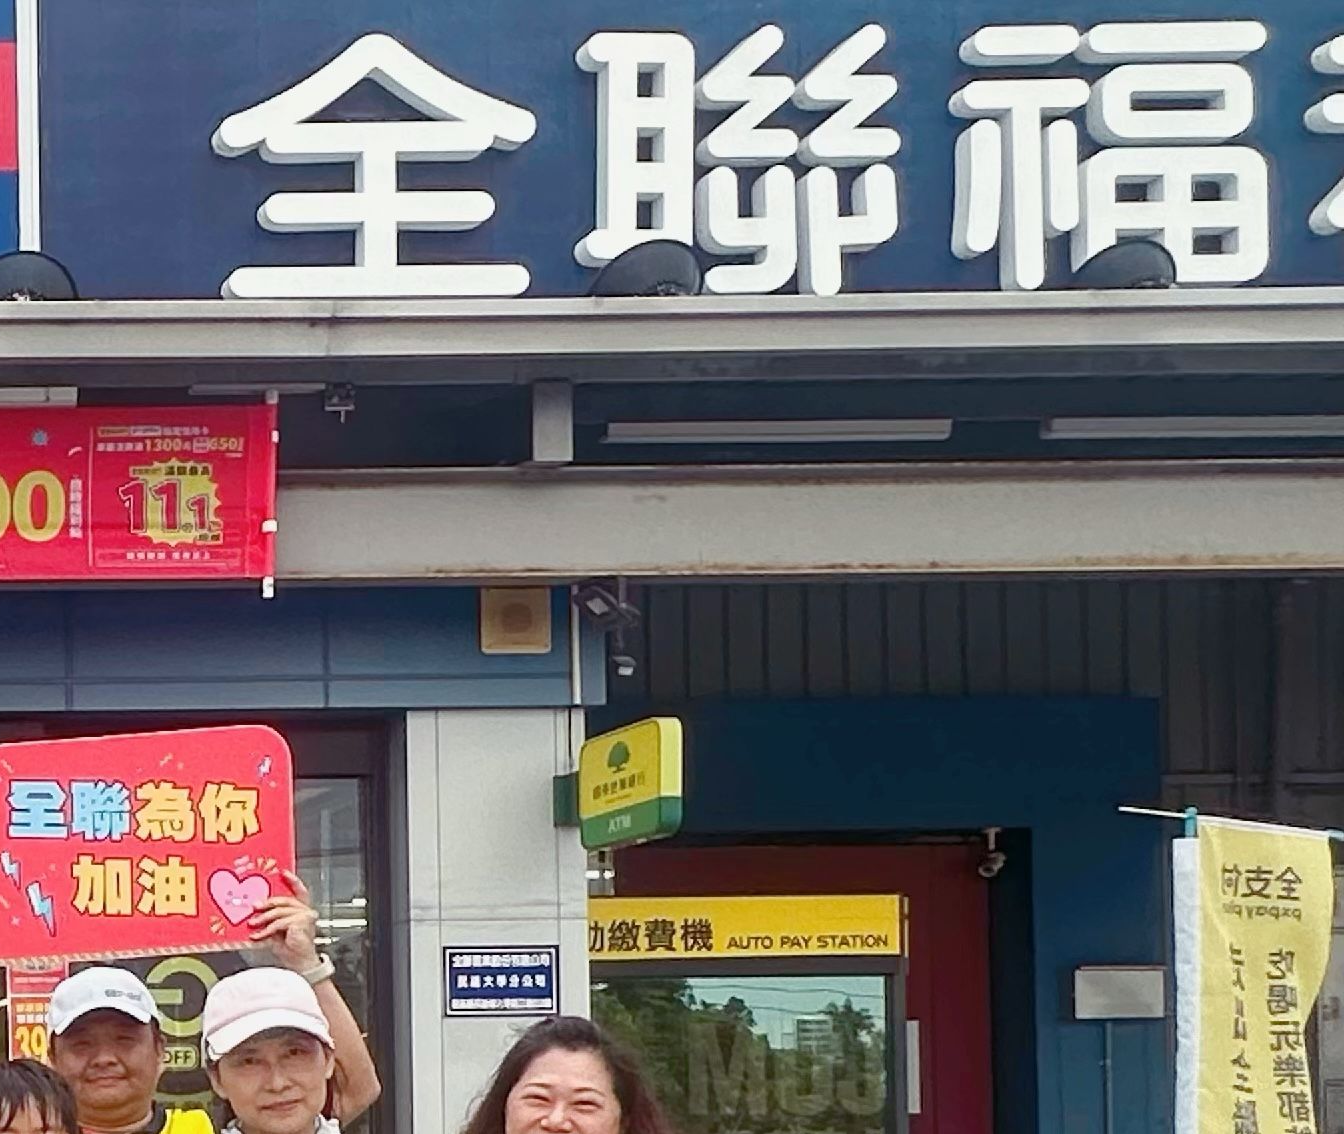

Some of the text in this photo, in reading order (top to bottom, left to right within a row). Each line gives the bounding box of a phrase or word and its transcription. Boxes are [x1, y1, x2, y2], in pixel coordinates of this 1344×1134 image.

[210, 18, 1344, 299] 全聯福
[5, 778, 262, 844] 全聯為你
[70, 852, 200, 918] 加油
[726, 933, 888, 950] AUTO PAY STATION
